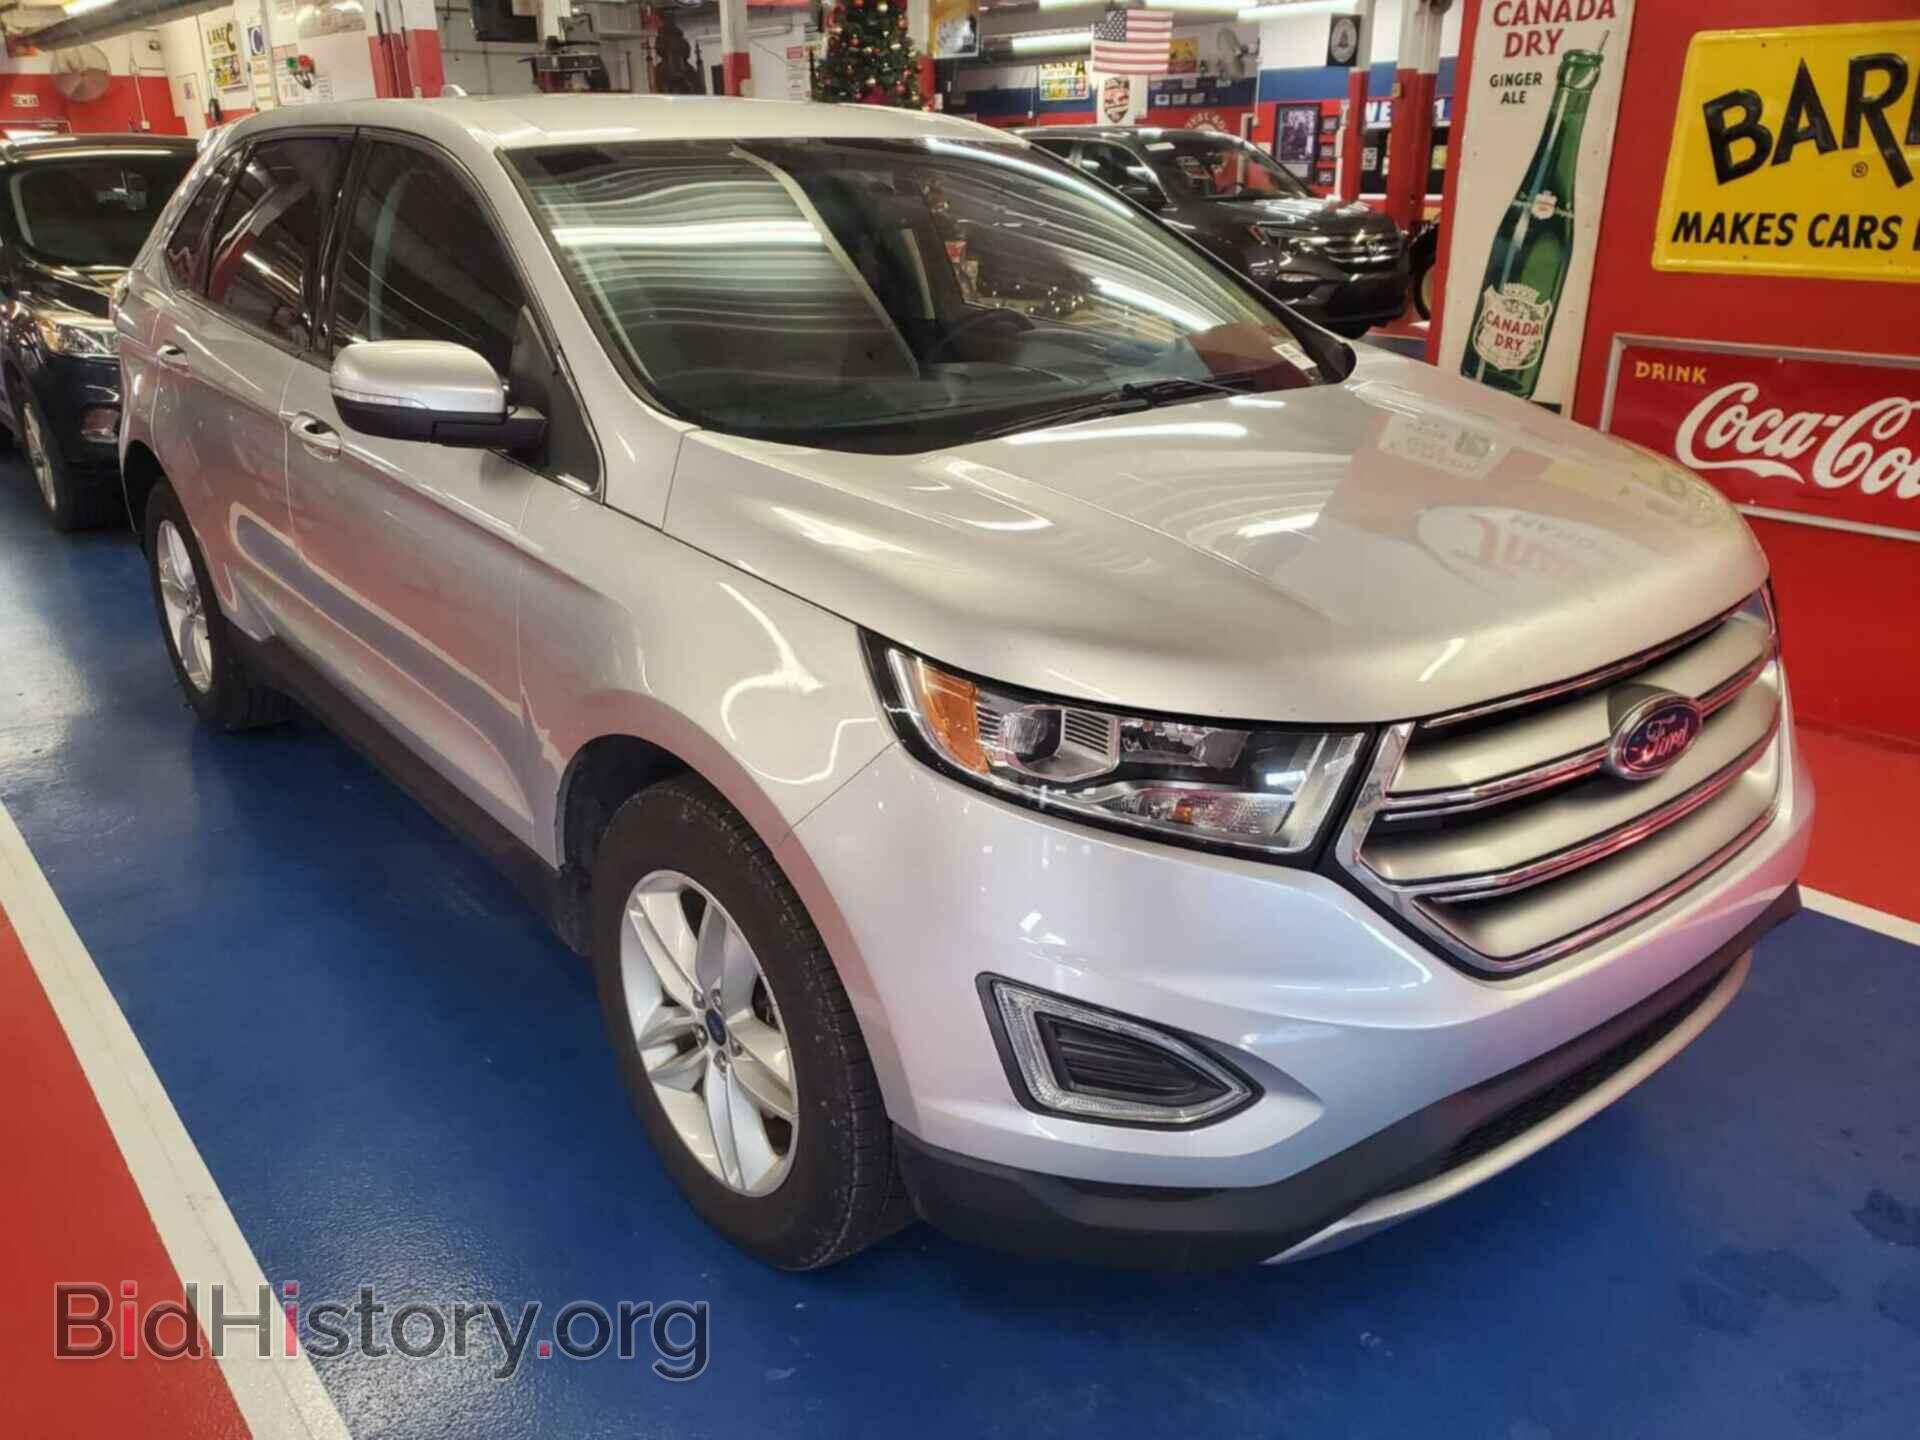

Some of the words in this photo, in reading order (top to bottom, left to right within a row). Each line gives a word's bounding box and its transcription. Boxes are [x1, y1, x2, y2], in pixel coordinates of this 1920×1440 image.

[1493, 0, 1616, 27] CANADA
[1504, 28, 1564, 58] DRY
[1489, 72, 1543, 88] GINGER
[1500, 91, 1527, 105] ALE
[1671, 211, 1798, 247] MAKES
[1807, 213, 1904, 251] CARS
[1485, 310, 1540, 337] CANADA
[1494, 333, 1526, 352] DRY
[1634, 361, 1708, 385] DRINK
[1630, 714, 1689, 763] Ford
